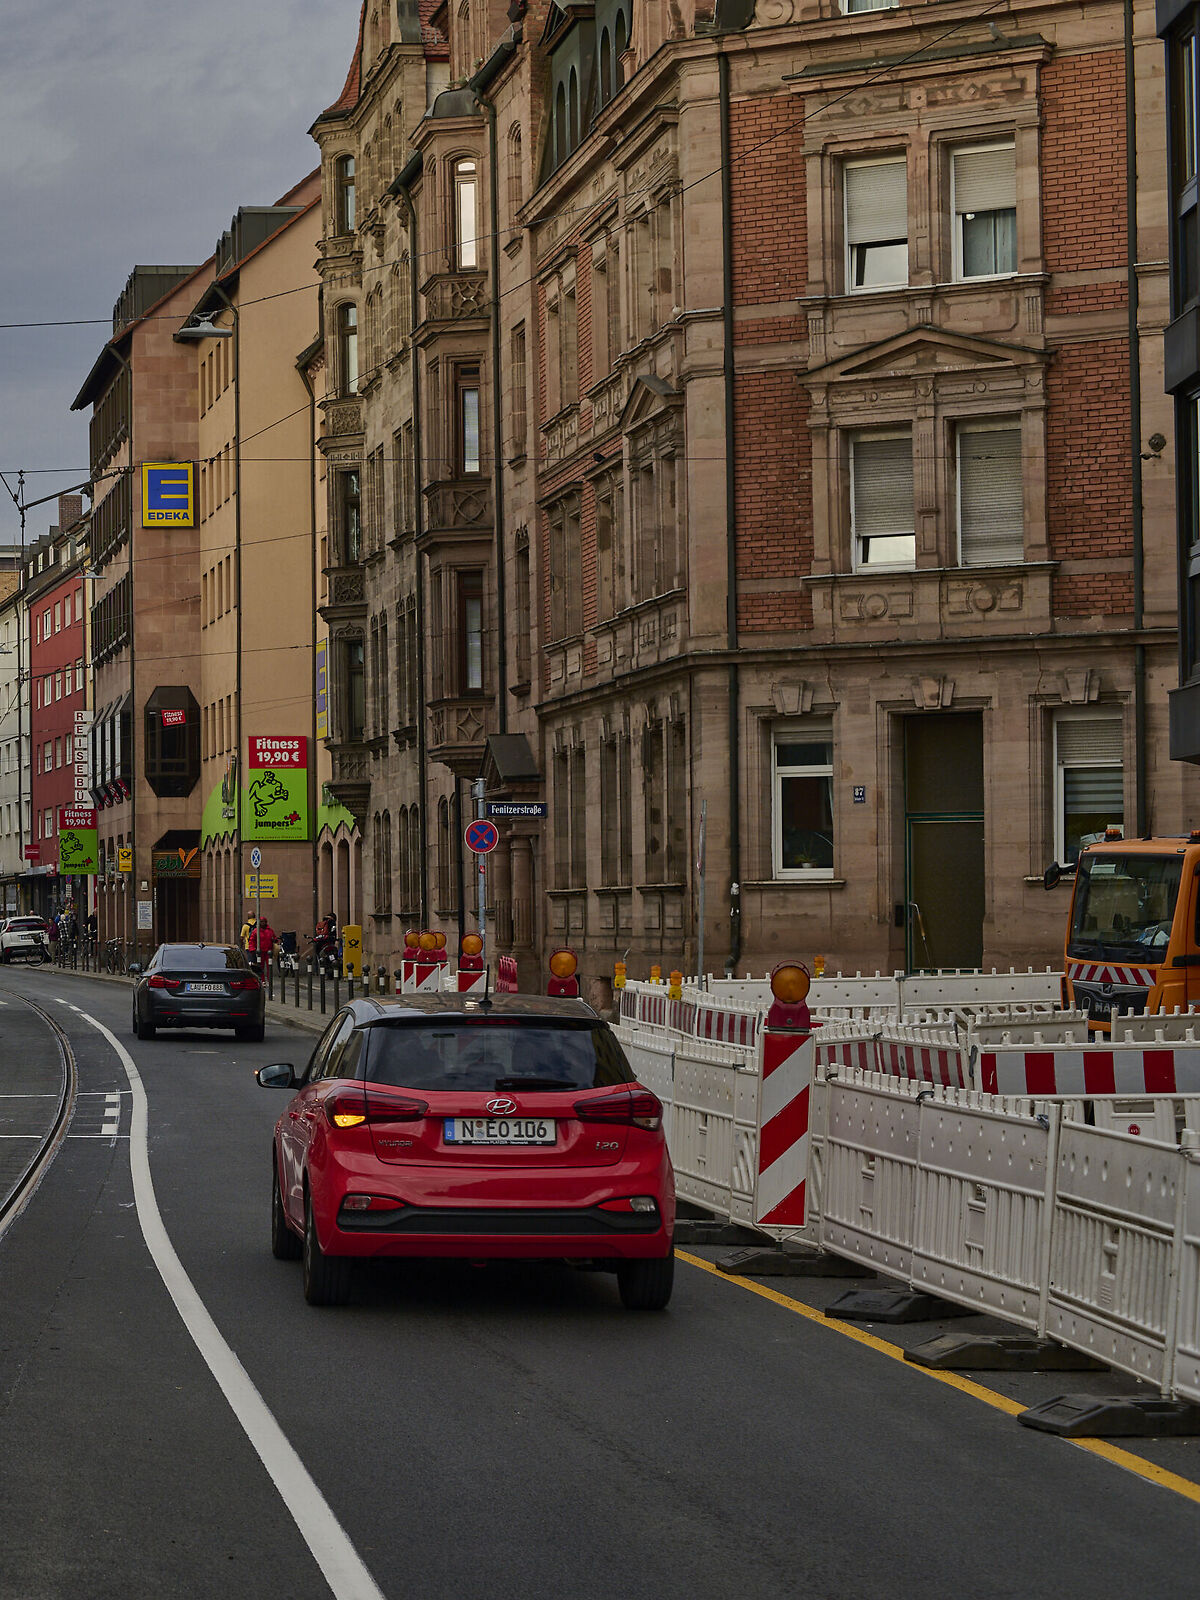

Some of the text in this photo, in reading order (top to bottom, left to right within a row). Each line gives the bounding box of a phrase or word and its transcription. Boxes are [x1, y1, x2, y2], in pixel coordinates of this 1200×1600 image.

[147, 511, 190, 521] EDEKA
[255, 737, 299, 750] Fitness
[256, 751, 300, 764] 19,90 €
[64, 809, 92, 818] Fitness
[491, 804, 542, 815] Fenitzerstraße
[64, 818, 92, 827] 19,90 €
[254, 818, 290, 829] jumpers
[462, 1120, 474, 1138] N
[513, 1120, 547, 1138] 106
